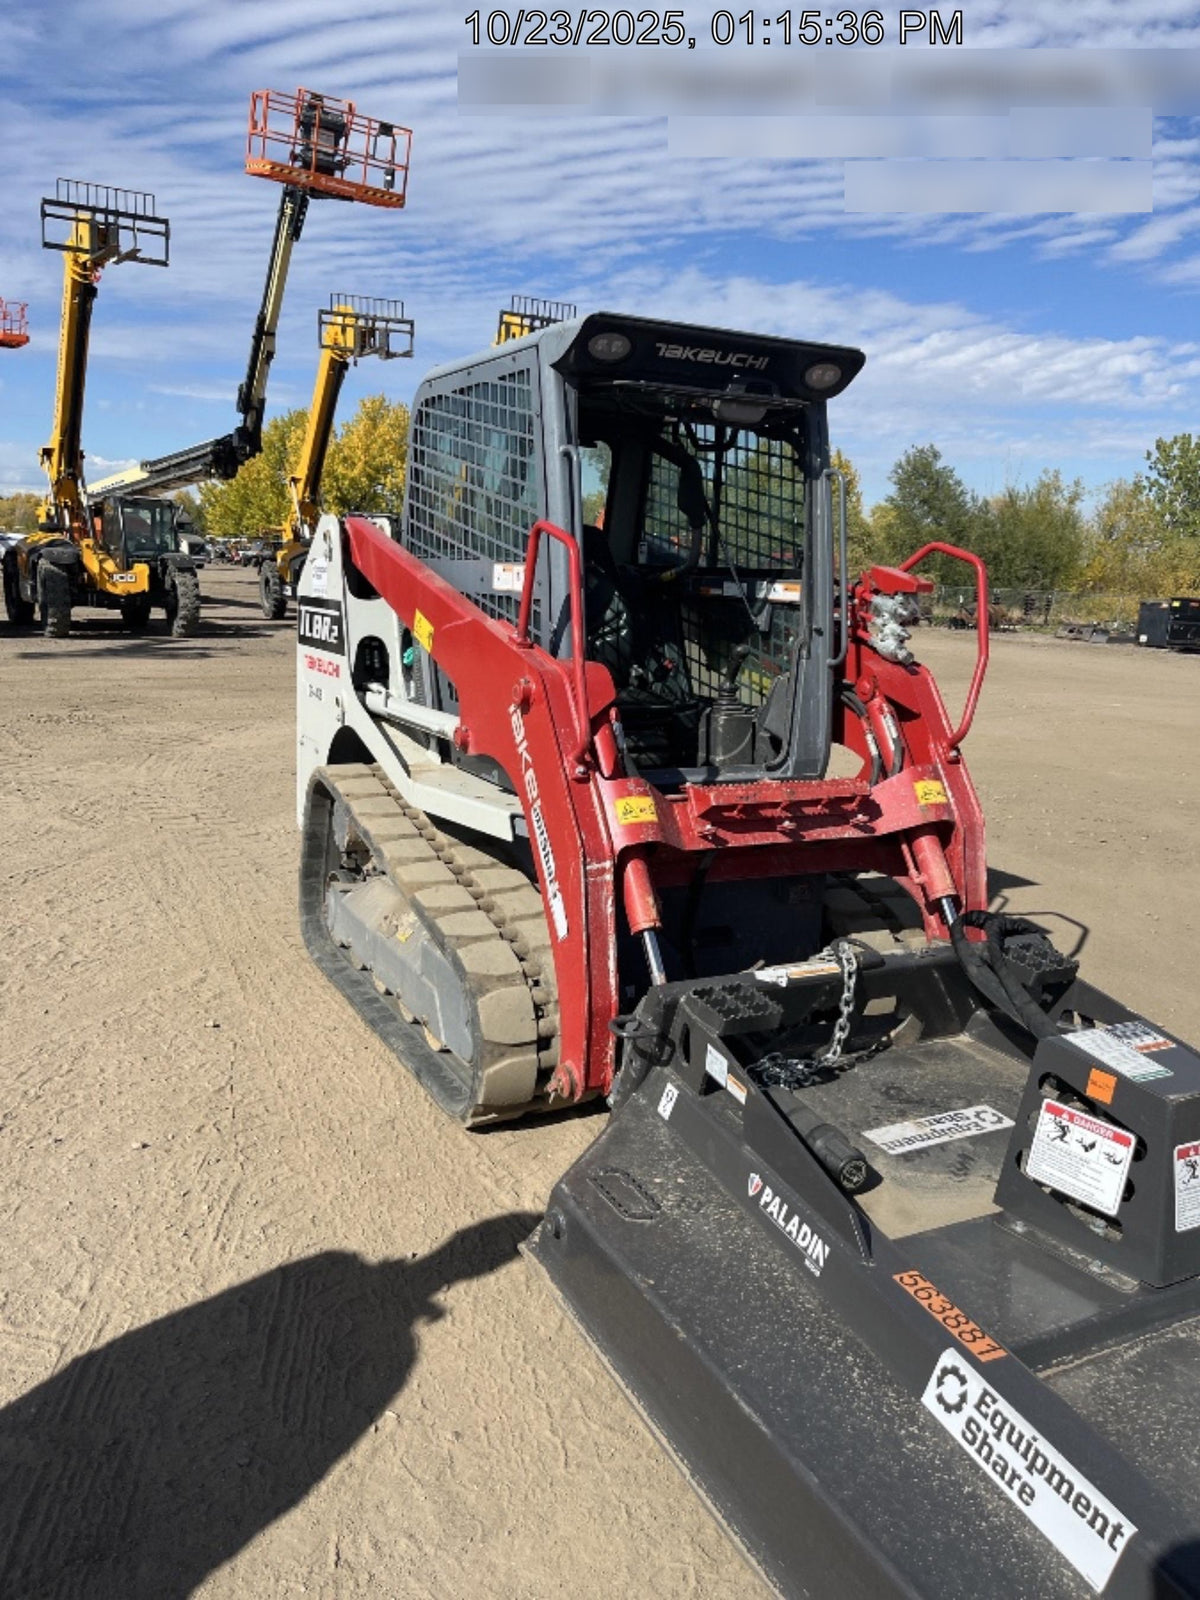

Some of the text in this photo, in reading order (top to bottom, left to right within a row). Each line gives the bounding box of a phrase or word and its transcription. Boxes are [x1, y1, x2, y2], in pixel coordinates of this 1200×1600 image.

[760, 1185, 831, 1269] PALADIN
[961, 1415, 1036, 1507] Share
[973, 1387, 1124, 1553] Equipment
